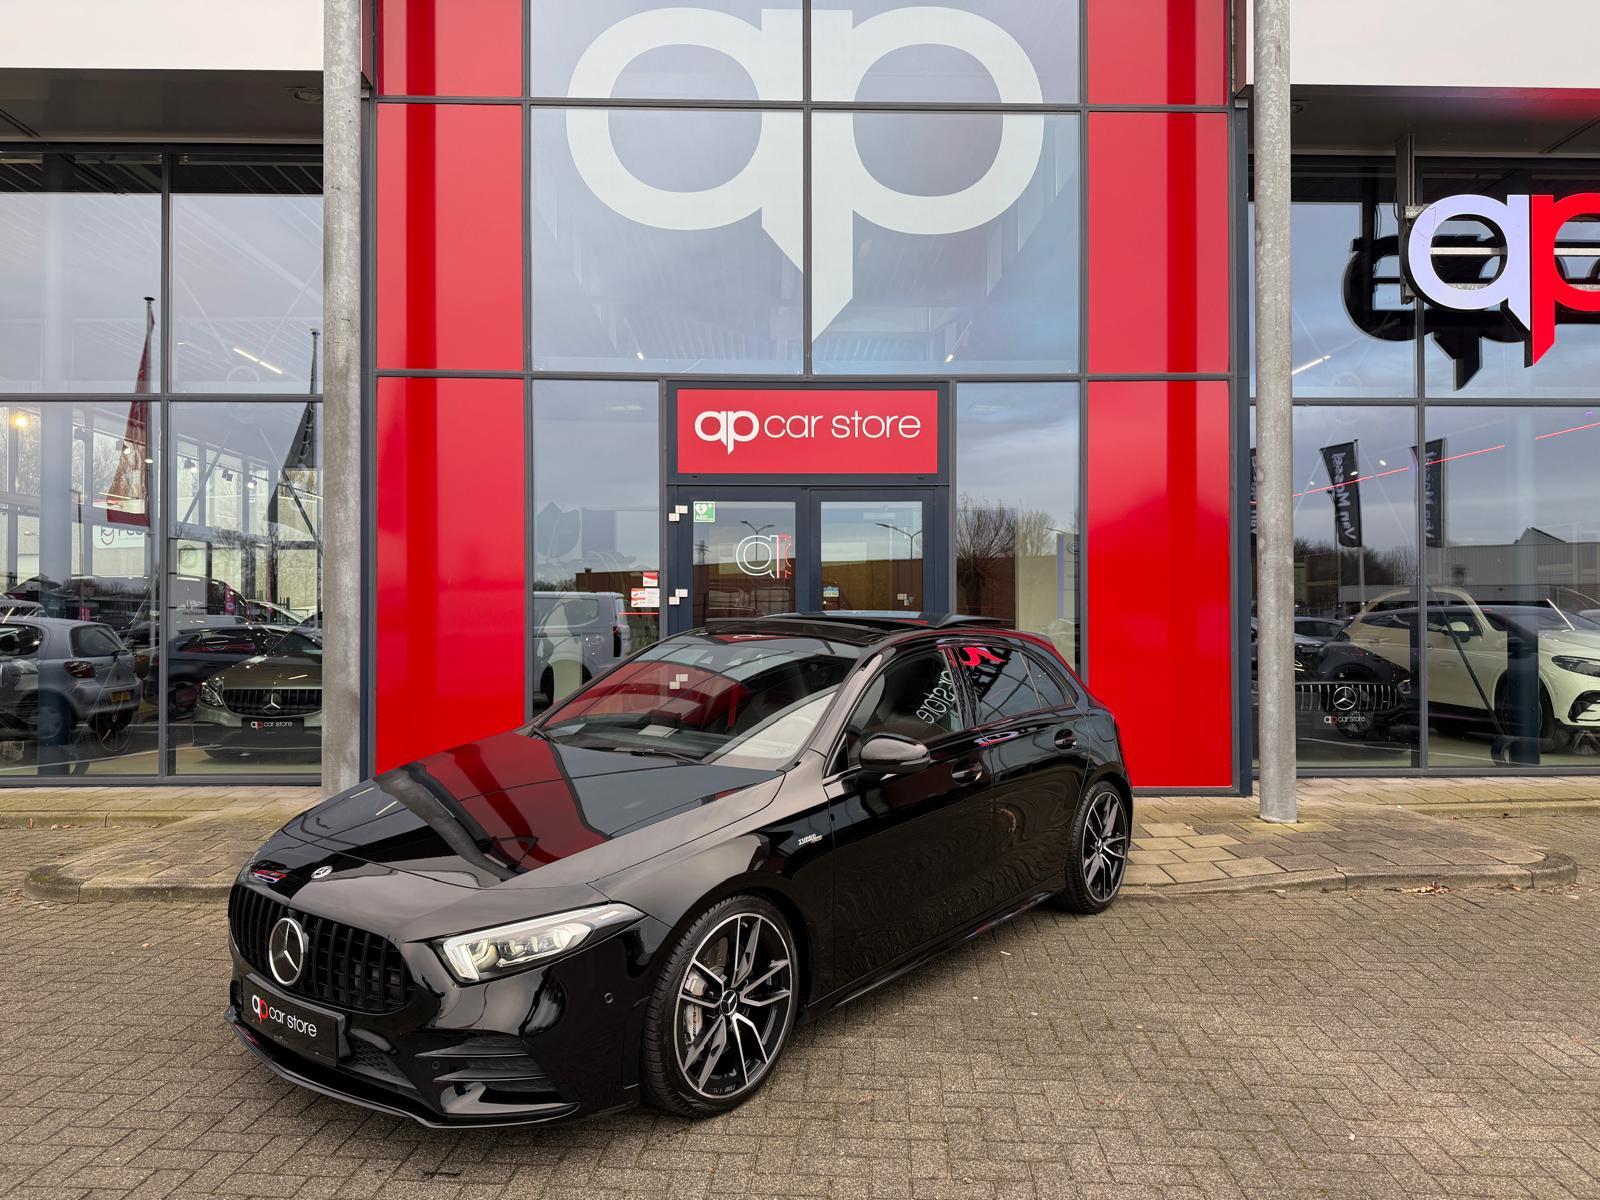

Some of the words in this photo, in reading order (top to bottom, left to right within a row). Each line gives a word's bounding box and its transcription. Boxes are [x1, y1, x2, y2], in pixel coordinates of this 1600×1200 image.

[566, 6, 1045, 343] ap
[694, 410, 760, 455] ap
[763, 414, 824, 439] car
[831, 410, 921, 439] store
[268, 1006, 285, 1025] car
[287, 1014, 317, 1038] store
